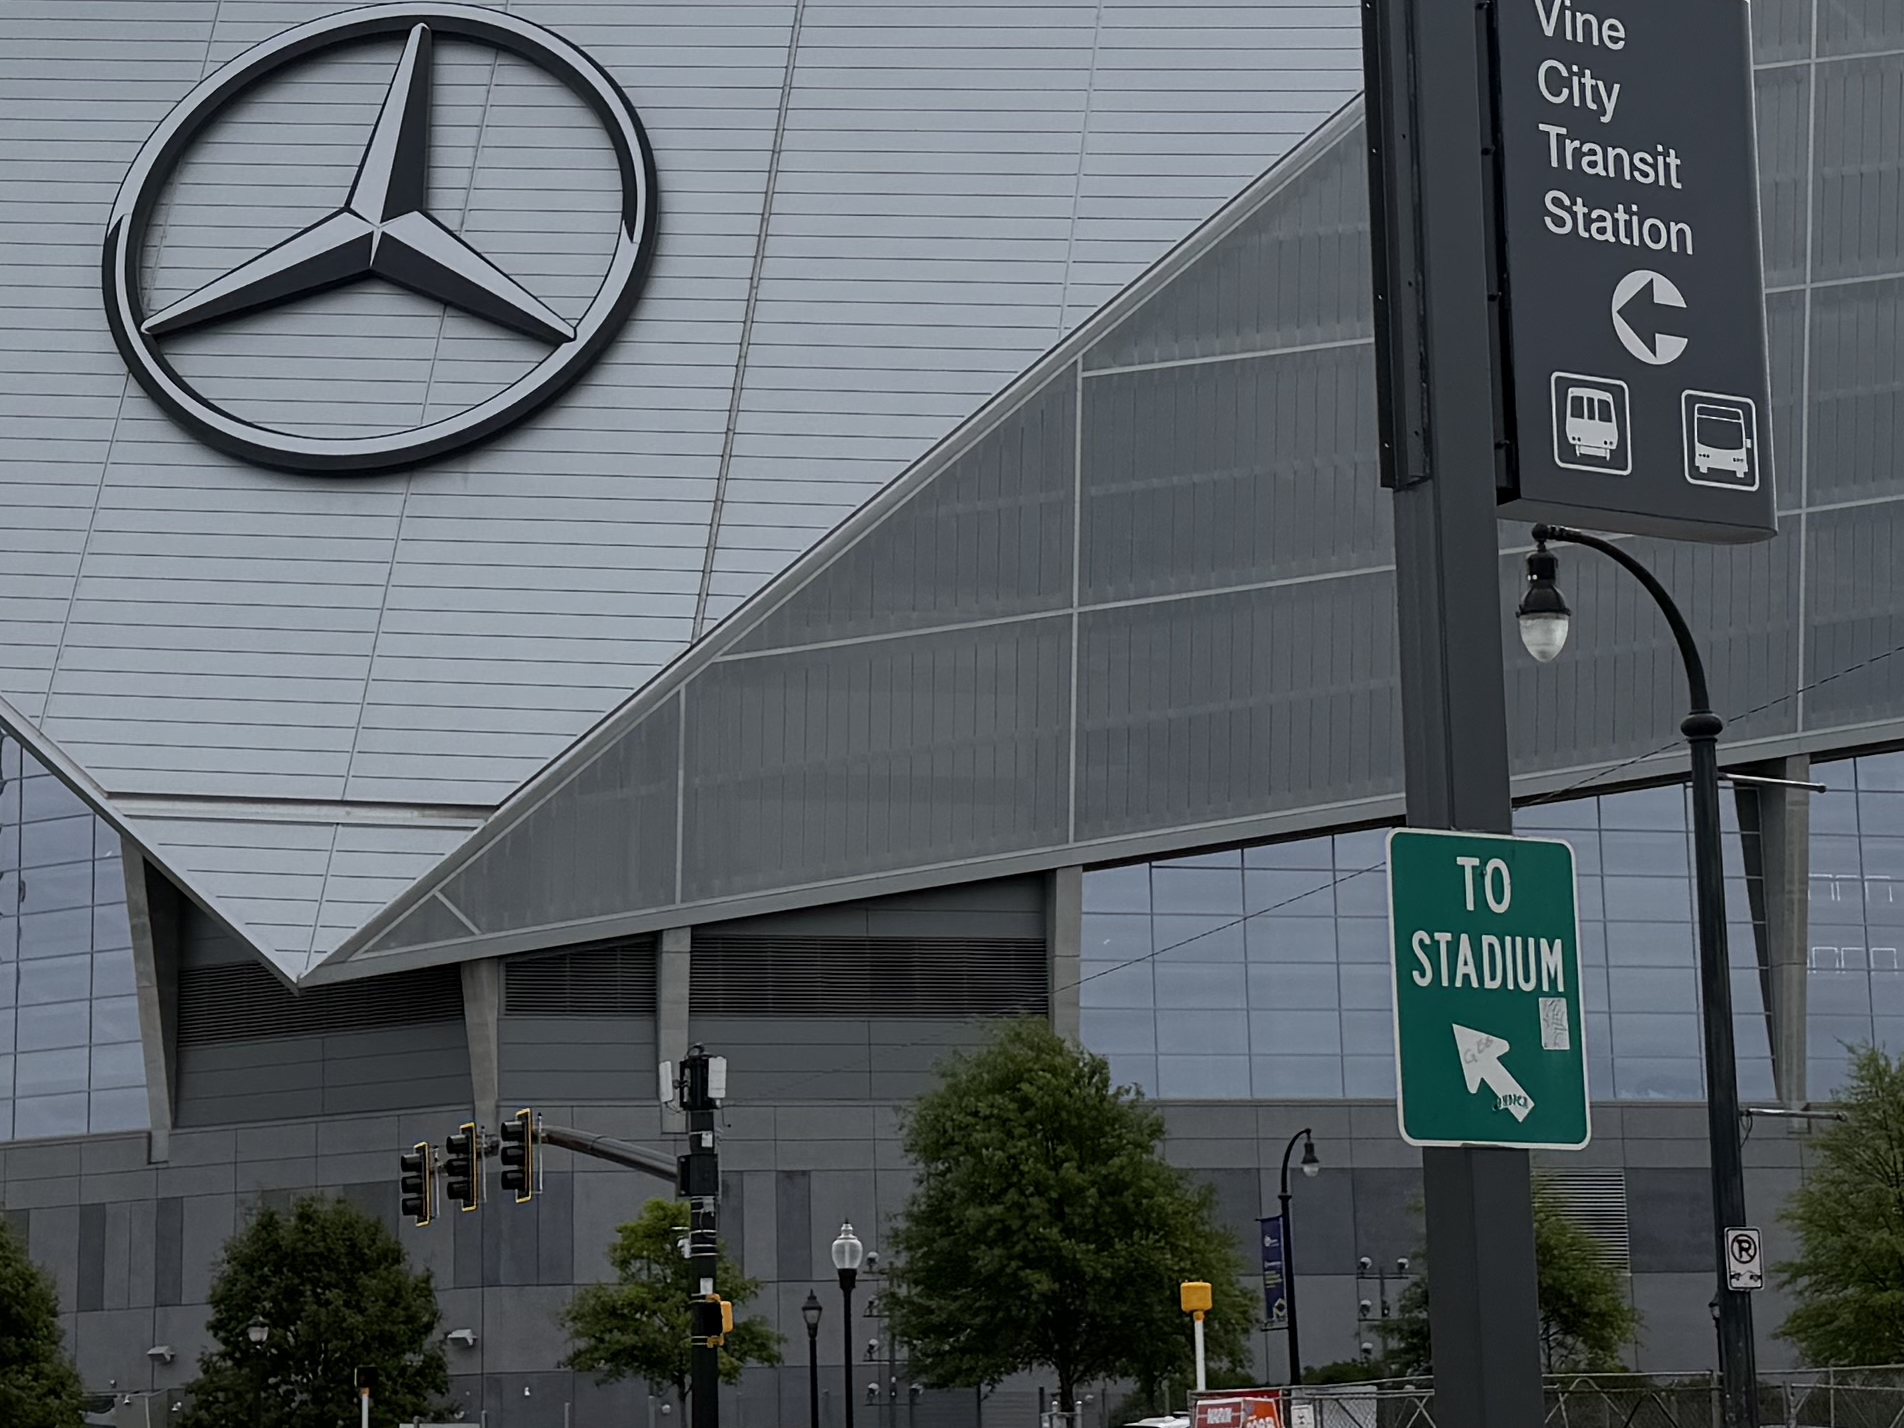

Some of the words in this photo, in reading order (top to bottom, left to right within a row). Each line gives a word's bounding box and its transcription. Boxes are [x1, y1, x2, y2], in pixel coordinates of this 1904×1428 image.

[1537, 59, 1621, 123] City
[1538, 123, 1682, 189] Transit
[1544, 189, 1694, 256] Station
[1456, 856, 1512, 914] TO
[1411, 930, 1565, 993] STADIUM
